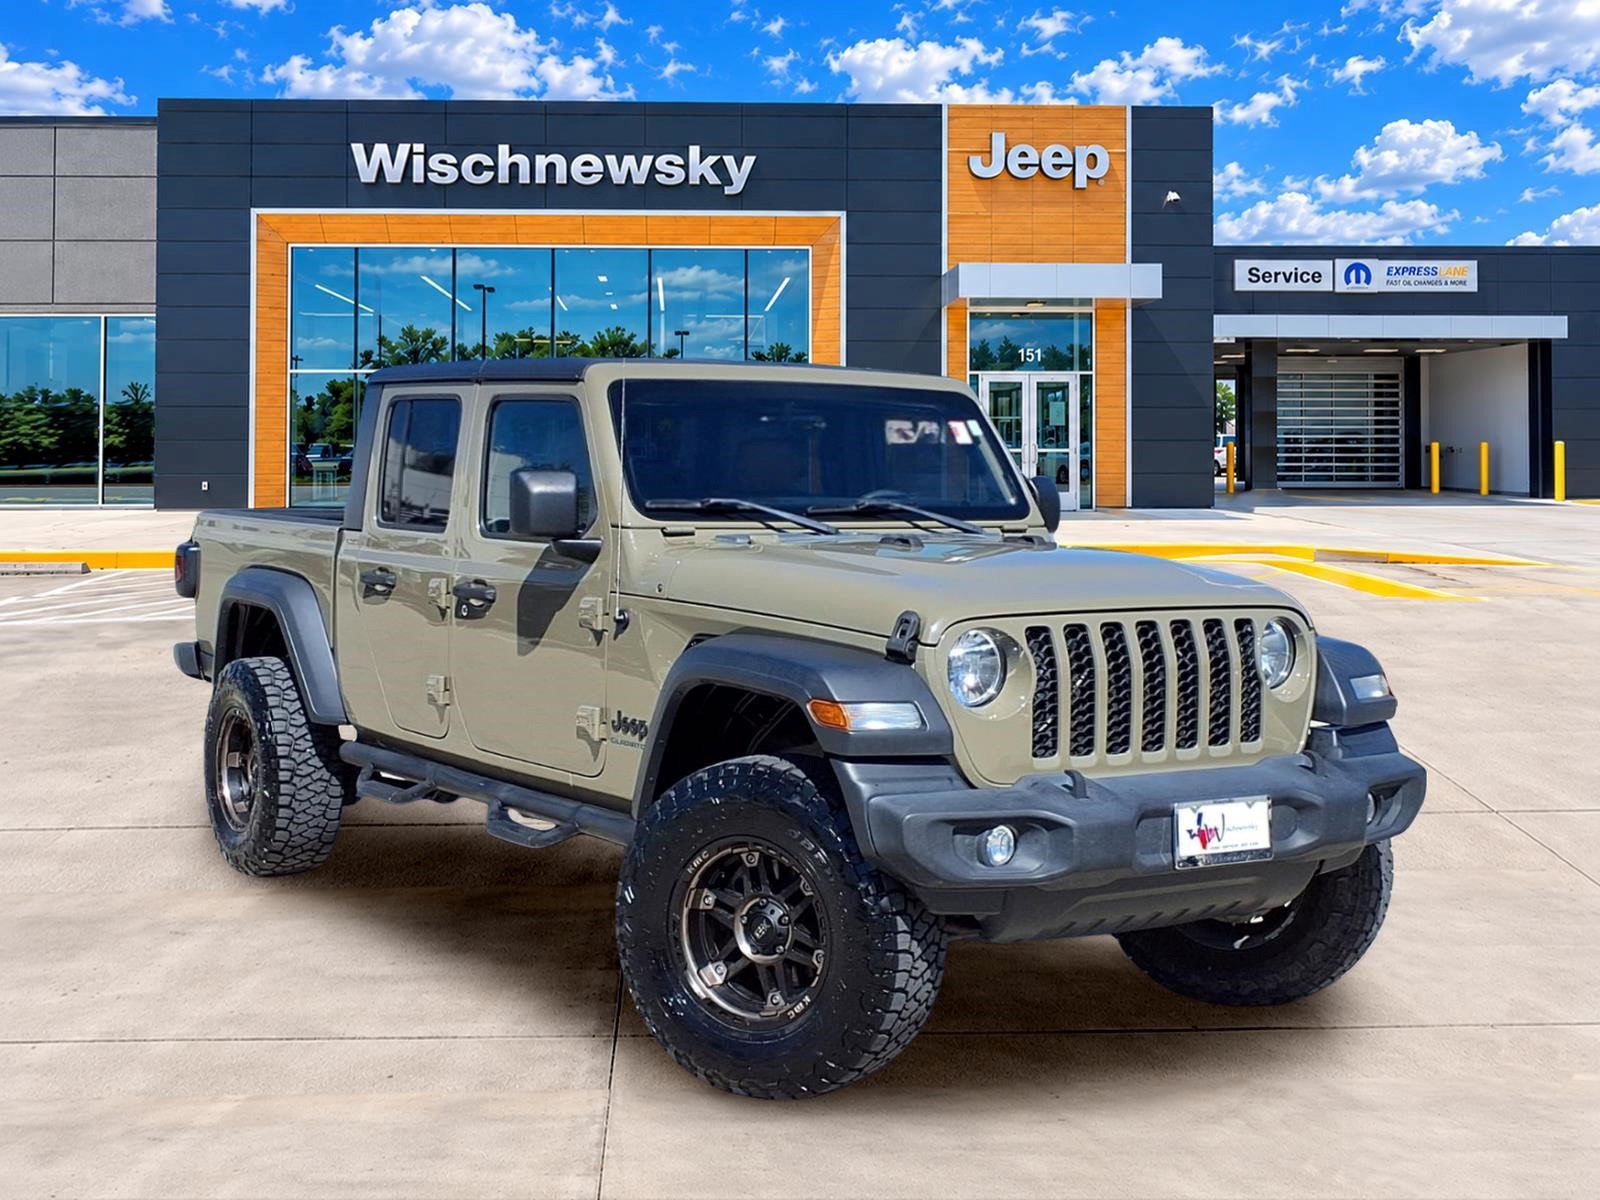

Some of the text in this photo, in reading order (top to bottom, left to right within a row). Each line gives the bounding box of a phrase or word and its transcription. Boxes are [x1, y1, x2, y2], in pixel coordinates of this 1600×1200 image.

[350, 142, 757, 195] Wischnewsky
[968, 131, 1110, 189] Jeep
[1247, 267, 1323, 284] Service
[1018, 347, 1042, 362] 151
[611, 709, 648, 742] Jeep
